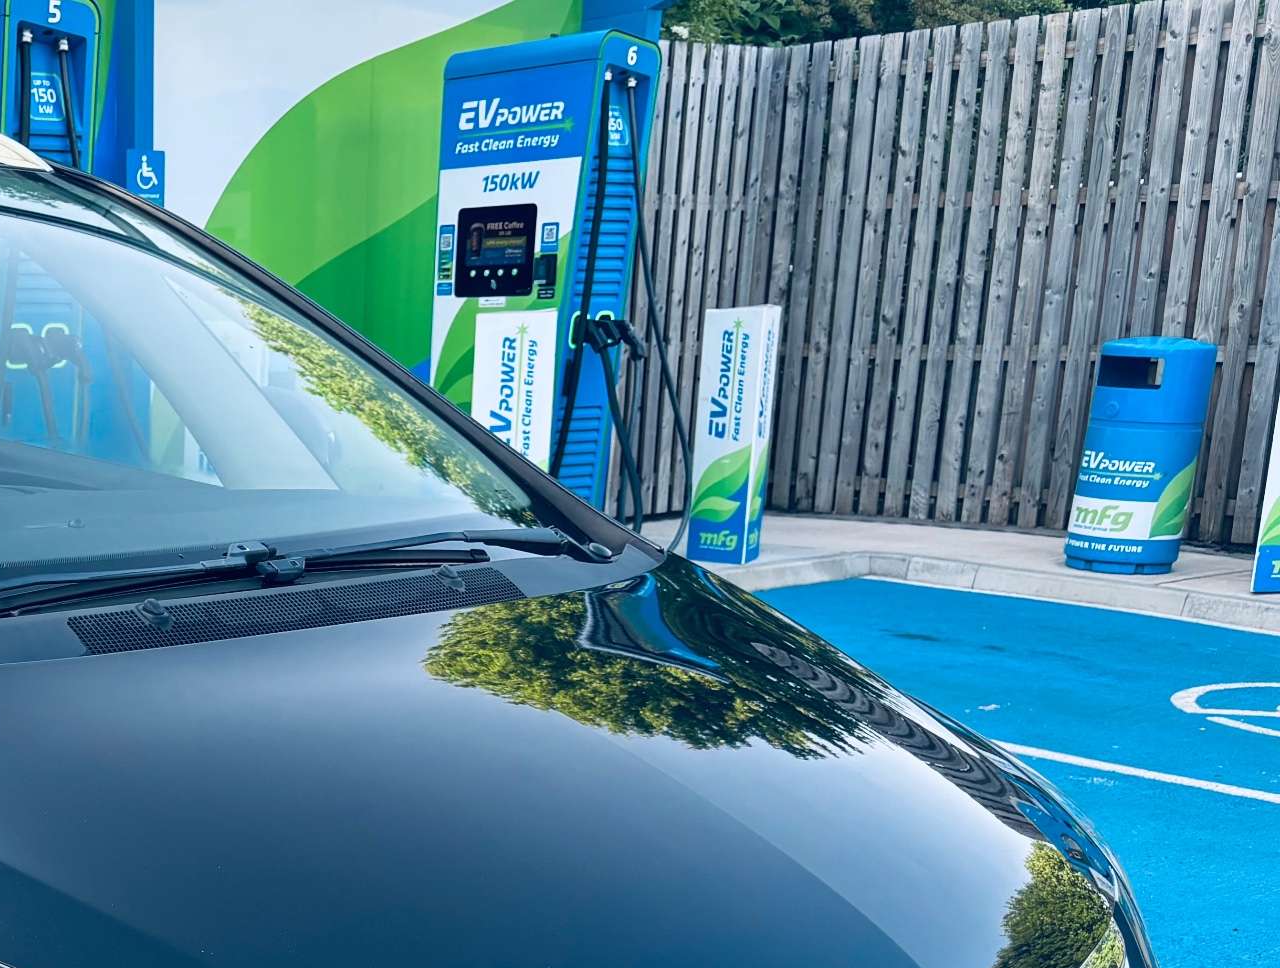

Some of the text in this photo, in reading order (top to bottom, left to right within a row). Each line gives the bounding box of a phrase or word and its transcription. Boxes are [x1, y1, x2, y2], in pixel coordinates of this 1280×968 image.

[48, 0, 61, 24] 5
[627, 45, 638, 66] 6
[31, 88, 57, 104] 150
[455, 134, 560, 155] Fast Clean Energy
[481, 170, 540, 193] 150kW
[524, 339, 538, 386] Energy
[732, 332, 750, 442] Fast Clean Energy
[522, 389, 533, 427] Clean
[1089, 474, 1112, 485] Clean
[1113, 476, 1149, 488] Energy
[1075, 505, 1134, 532] mfg
[699, 530, 738, 551] mfg
[1090, 542, 1107, 551] THE
[1108, 544, 1143, 553] FUTURE
